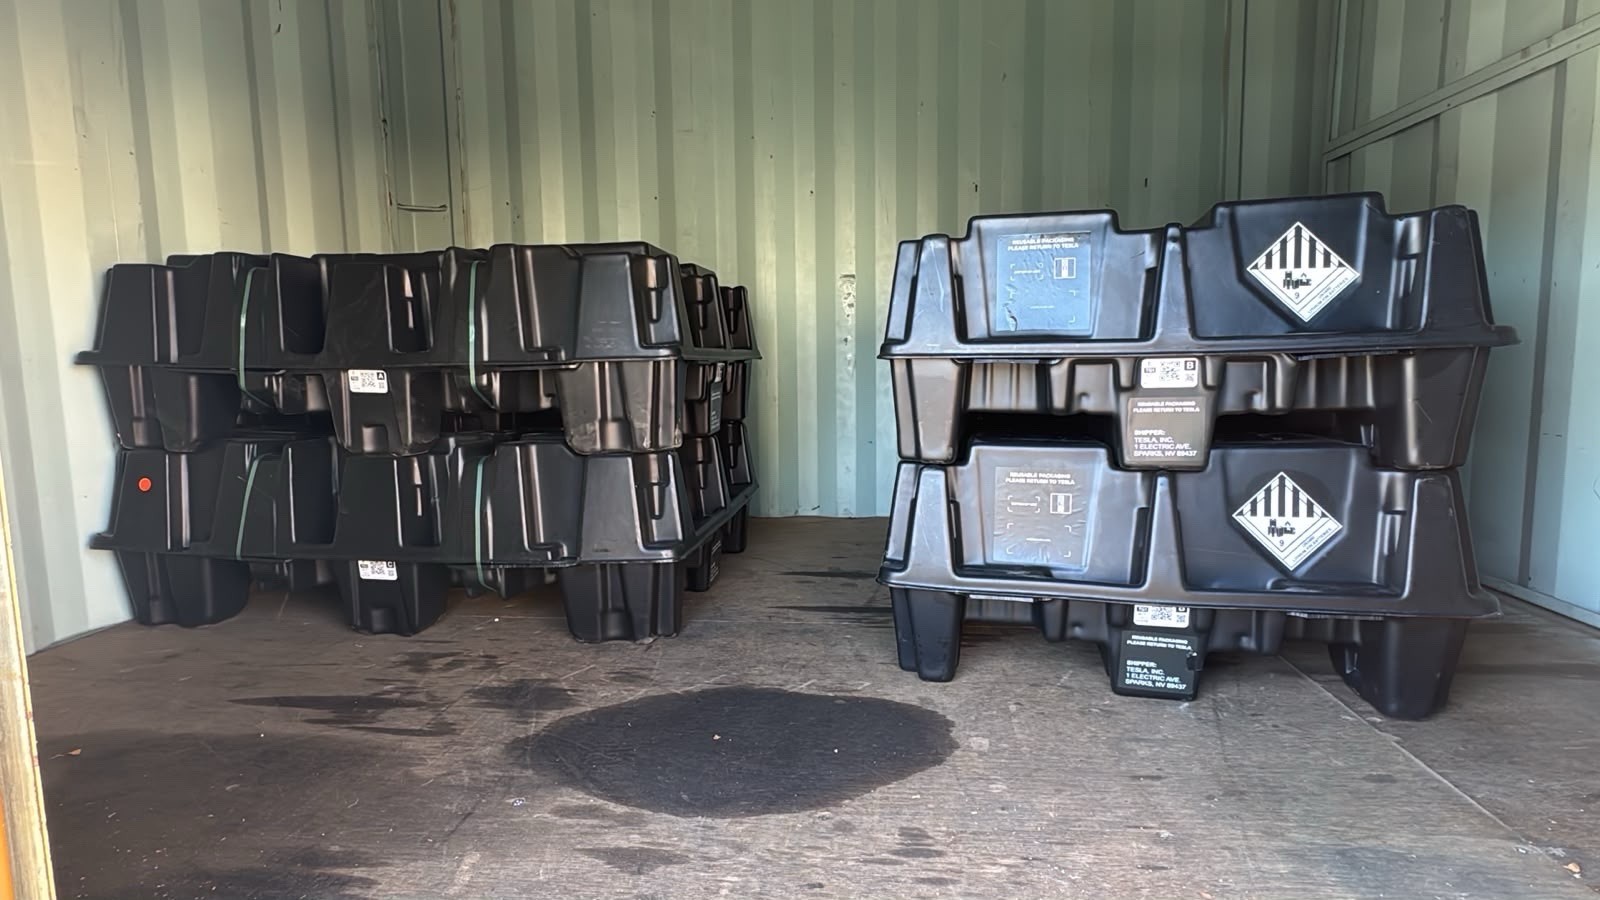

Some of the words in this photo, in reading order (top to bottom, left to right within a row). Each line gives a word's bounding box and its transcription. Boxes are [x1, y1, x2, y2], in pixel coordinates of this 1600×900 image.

[1294, 292, 1300, 300] 9
[1158, 637, 1188, 645] PACKAGING
[1131, 673, 1165, 682] ELECTRIC
[1125, 679, 1154, 687] SPARKS,
[1166, 682, 1187, 690] 89437
